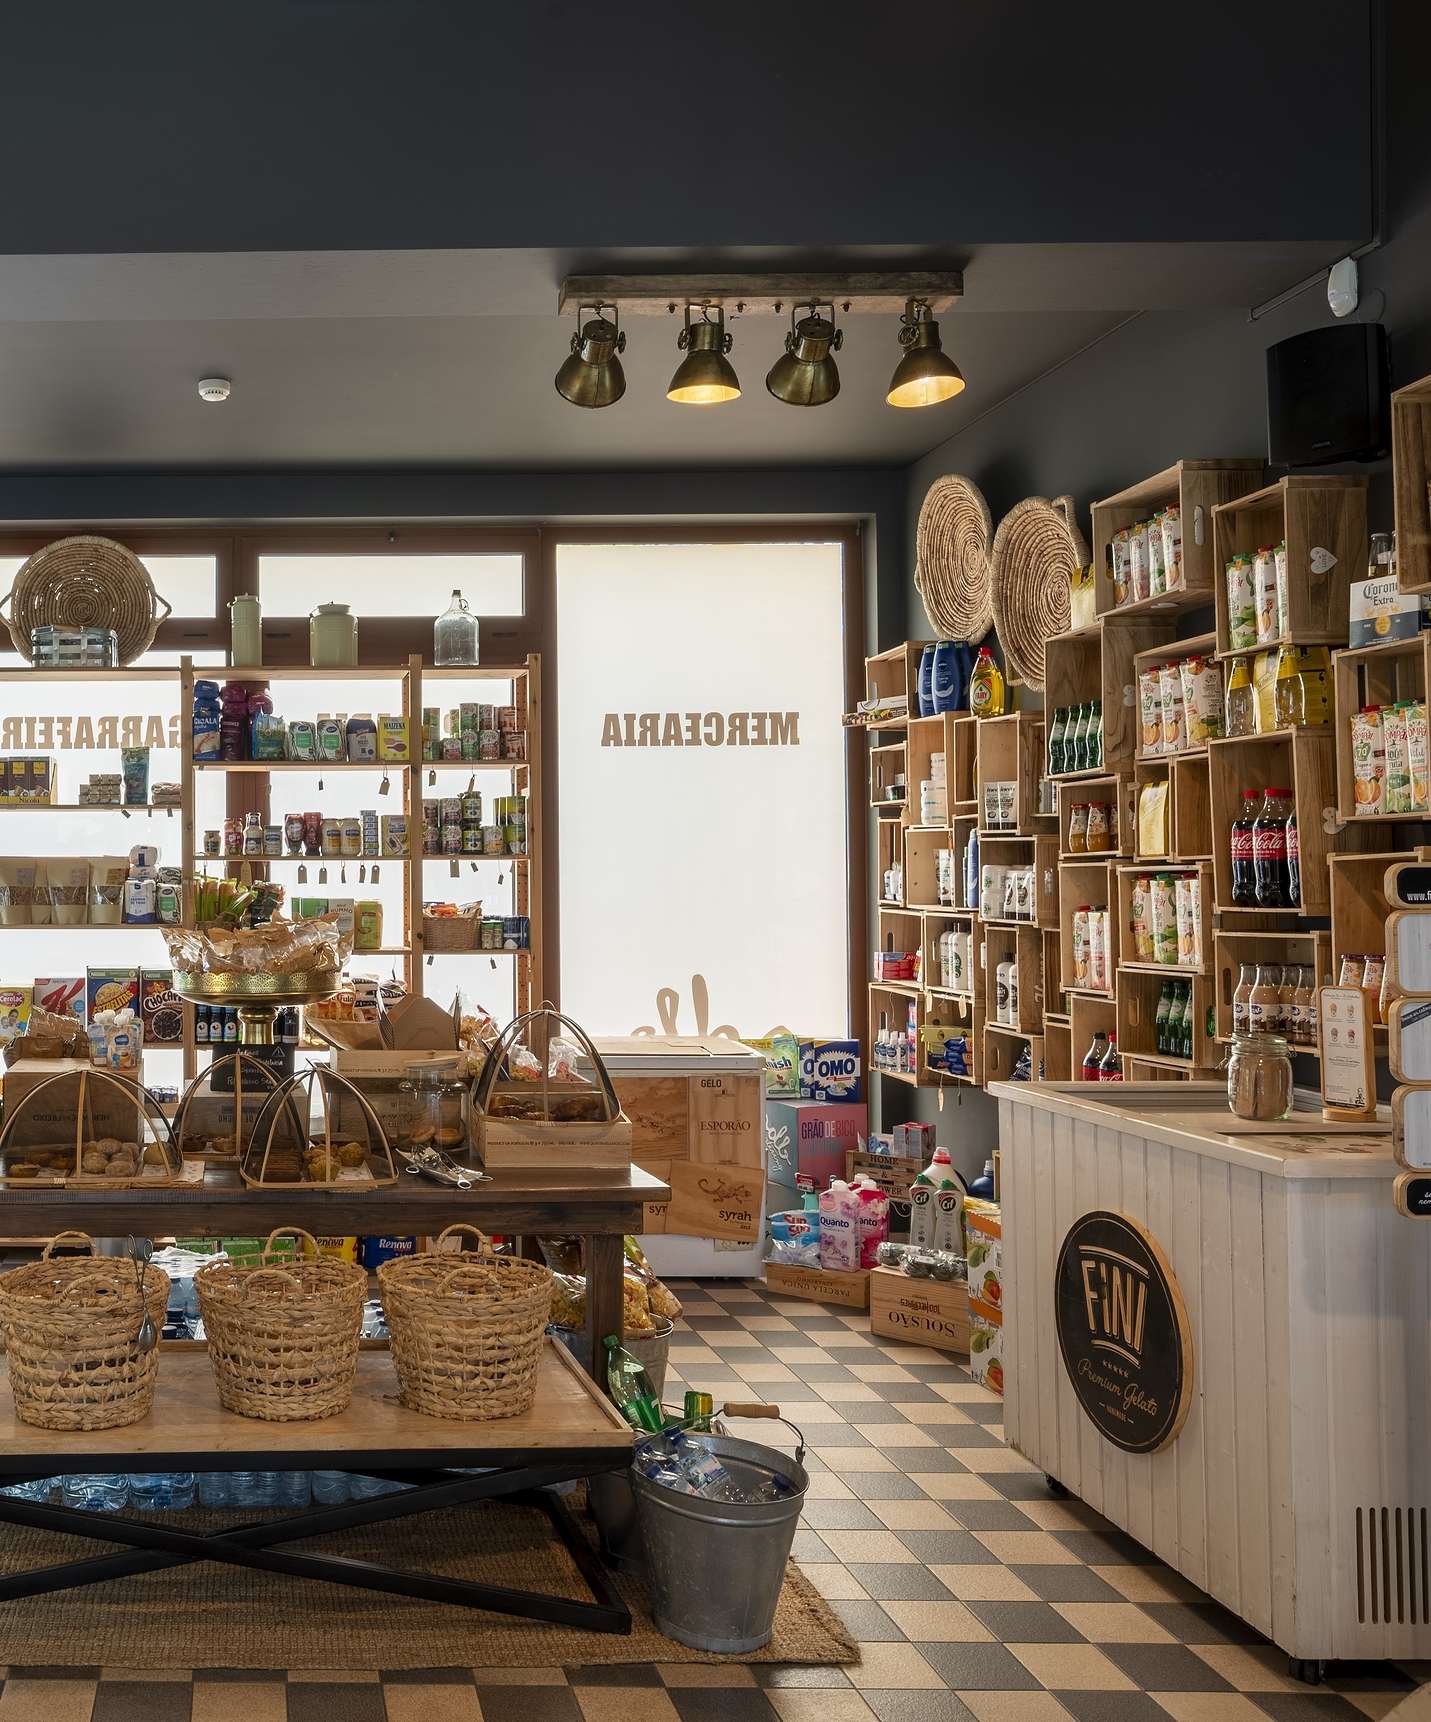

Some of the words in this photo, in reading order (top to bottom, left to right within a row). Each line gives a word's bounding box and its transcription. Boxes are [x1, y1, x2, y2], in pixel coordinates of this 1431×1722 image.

[1363, 582, 1397, 599] Coron
[1373, 595, 1394, 606] Extra
[145, 990, 182, 1010] CHOCAP
[818, 1058, 856, 1078] OMO
[701, 1079, 722, 1088] GELO
[700, 1119, 751, 1131] ESPORÃO
[825, 1120, 836, 1138] DE
[915, 1191, 928, 1204] Cif
[649, 1205, 668, 1216] syr
[720, 1209, 752, 1222] syrah
[820, 1216, 850, 1229] Quanto
[860, 1217, 878, 1227] anto
[317, 1238, 344, 1246] enova
[379, 1238, 413, 1249] Renova
[1081, 1259, 1147, 1355] FINI
[888, 1311, 956, 1338] SOUSÃO
[1078, 1358, 1121, 1396] Premium
[1123, 1383, 1158, 1417] Gelato
